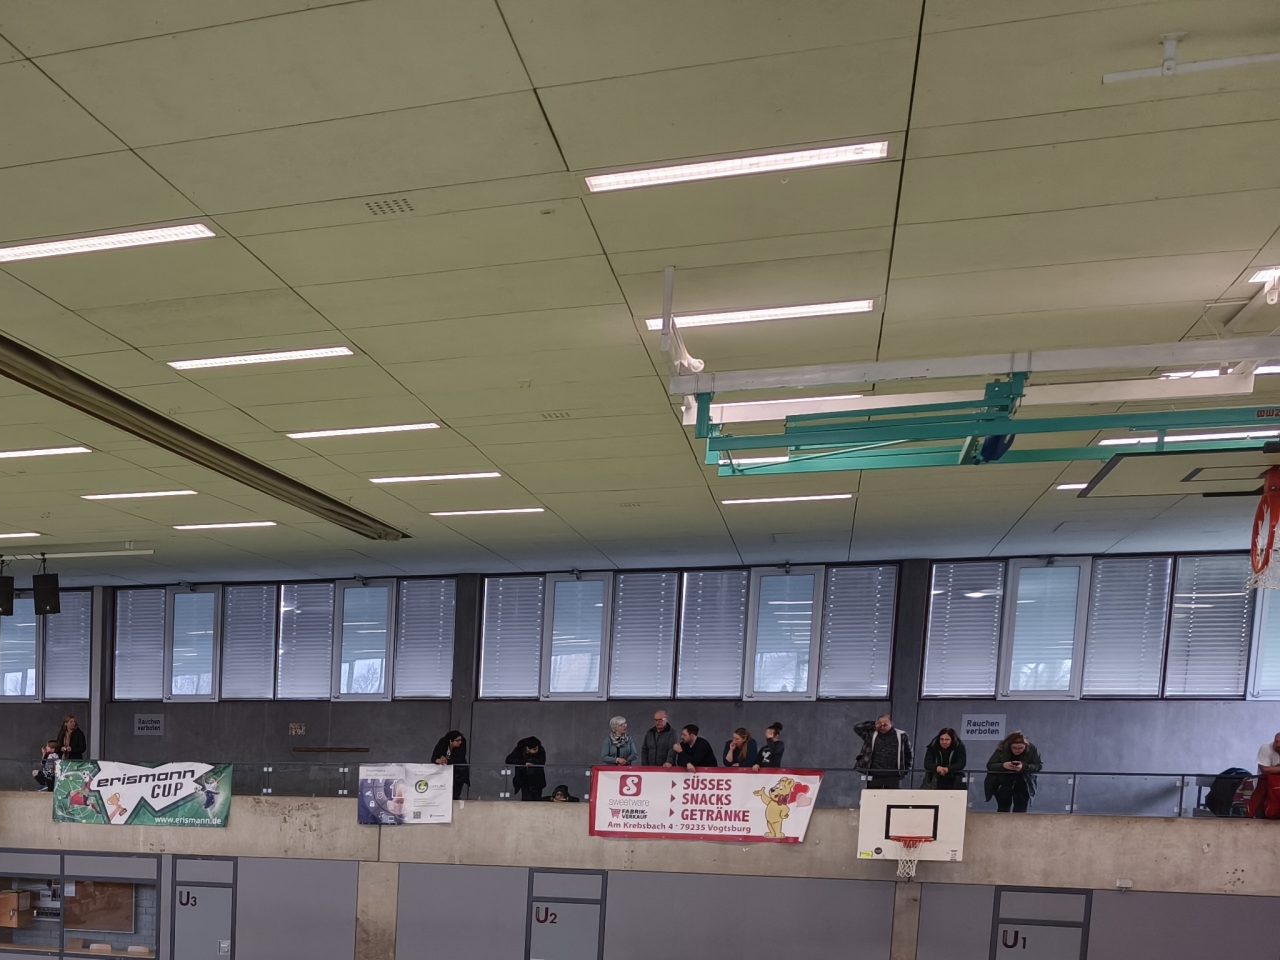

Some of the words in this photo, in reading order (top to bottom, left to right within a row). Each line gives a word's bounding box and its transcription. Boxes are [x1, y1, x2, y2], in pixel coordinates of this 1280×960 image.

[966, 719, 1000, 727] Rauchen
[966, 727, 1000, 735] verboten
[96, 769, 195, 788] erismann
[683, 776, 732, 791] SÜSSES
[150, 782, 184, 799] CUP
[608, 798, 650, 807] sweetware
[682, 793, 732, 806] SNACKS
[154, 816, 222, 825] www.erismann.de
[681, 807, 750, 822] GETRÄNKE
[607, 821, 621, 829] Am
[623, 822, 666, 830] Krebsbach
[680, 823, 706, 831] 79235
[708, 825, 752, 834] Vogtsburg
[179, 890, 197, 907] U3
[535, 906, 558, 924] U2
[1002, 929, 1027, 949] U1
